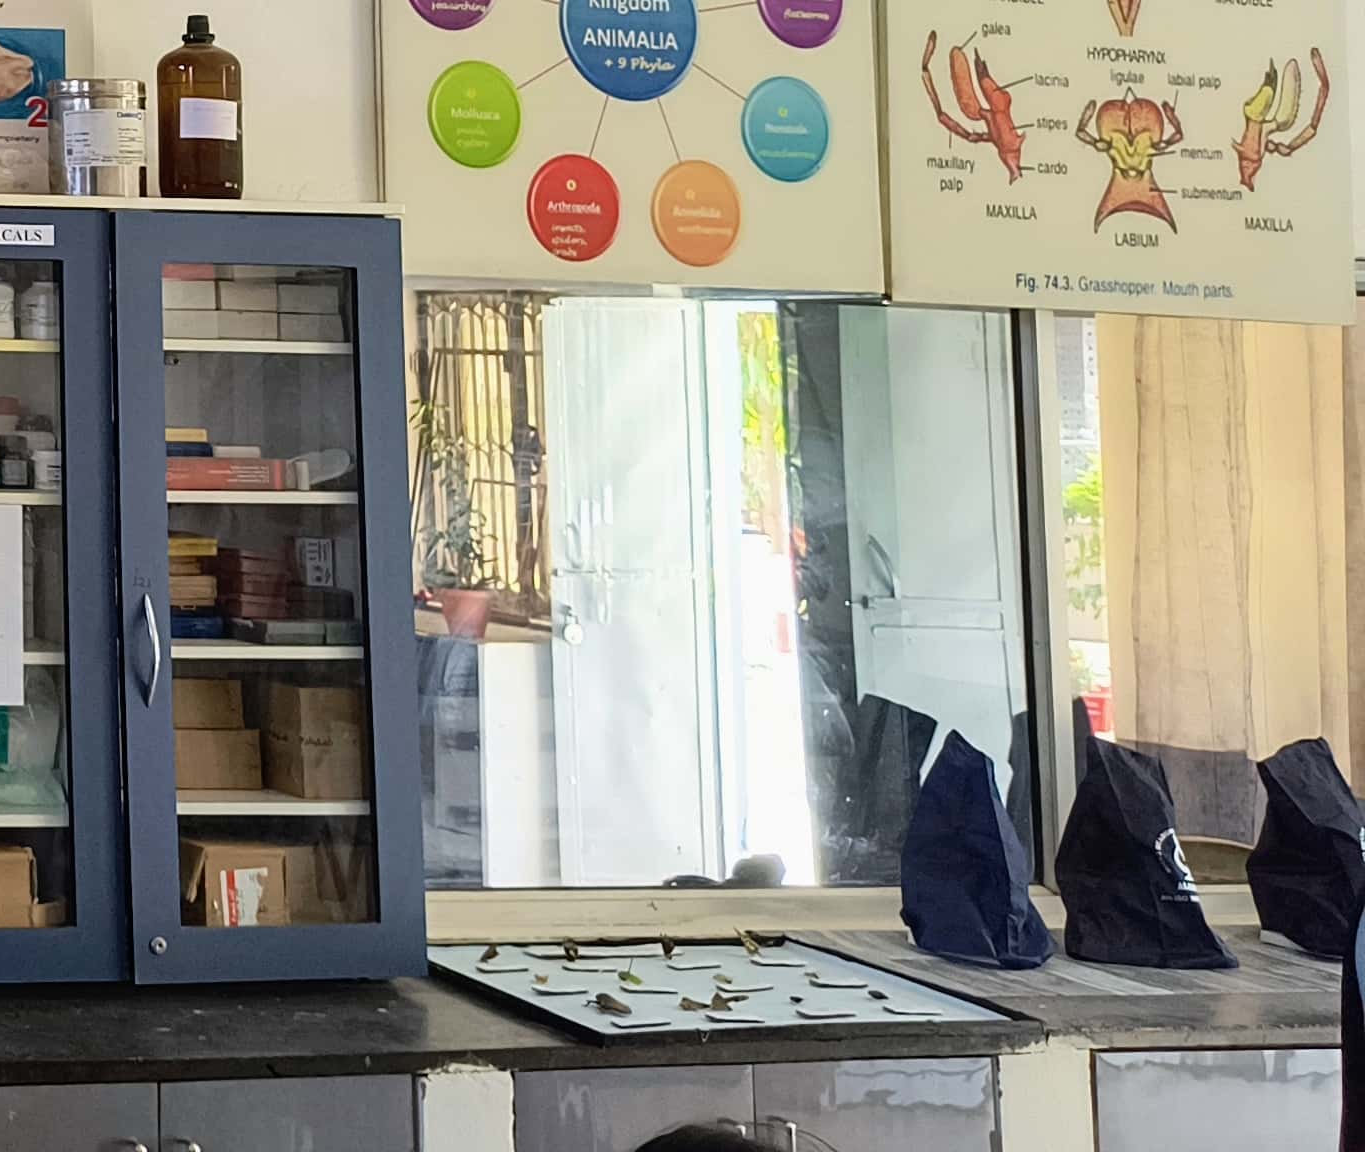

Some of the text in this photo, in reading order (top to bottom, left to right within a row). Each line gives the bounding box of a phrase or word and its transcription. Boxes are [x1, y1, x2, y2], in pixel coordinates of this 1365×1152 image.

[981, 22, 1011, 37] galea
[583, 28, 678, 51] ANIMALIA
[1086, 47, 1166, 64] HYPOPHARYNX
[618, 56, 675, 73] 9 Phyla
[1034, 73, 1069, 88] lacinia
[1109, 69, 1144, 86] ligulae
[1167, 73, 1222, 90] labial palp
[27, 97, 48, 128] 2
[1036, 118, 1068, 133] stipes
[1181, 148, 1222, 160] mentum
[927, 156, 974, 174] maxillary
[1038, 161, 1067, 176] cardo
[940, 177, 963, 192] palp
[1182, 188, 1242, 201] submentum
[986, 205, 1037, 220] MAXILLA
[1245, 217, 1293, 233] MAXILLA
[1115, 233, 1158, 248] LABIUM
[1016, 274, 1039, 291] Fig.
[1163, 282, 1199, 297] Mouth
